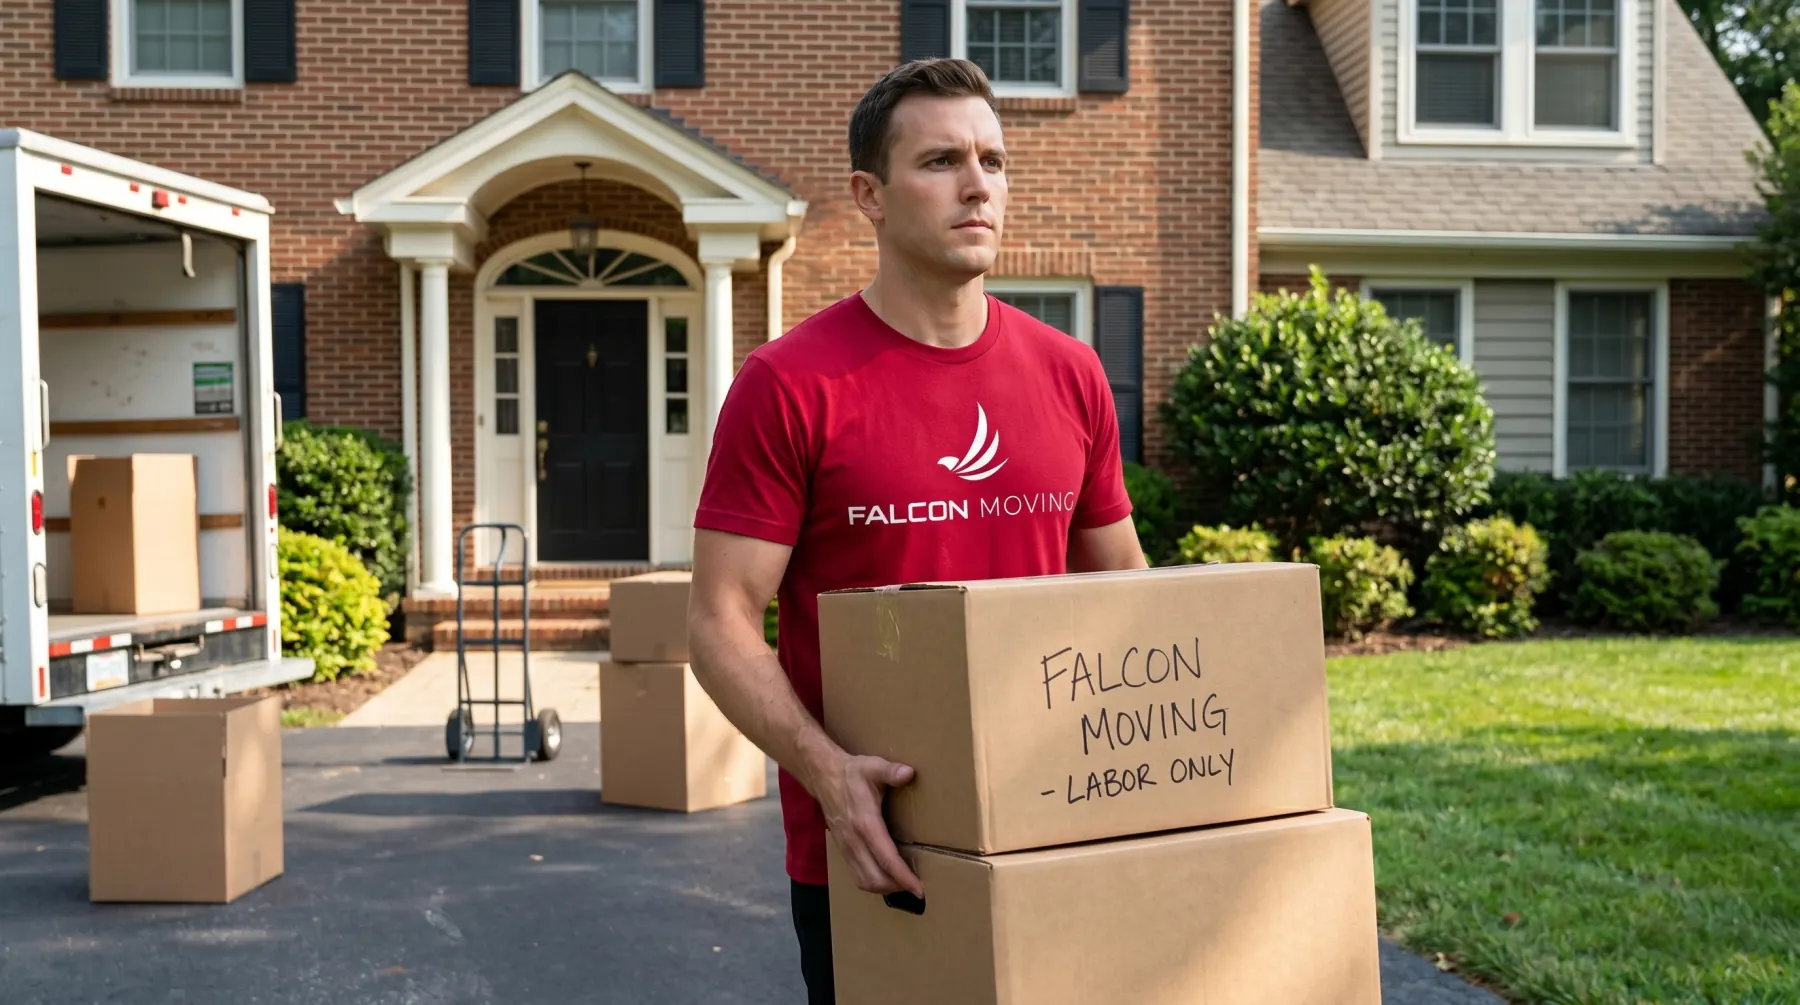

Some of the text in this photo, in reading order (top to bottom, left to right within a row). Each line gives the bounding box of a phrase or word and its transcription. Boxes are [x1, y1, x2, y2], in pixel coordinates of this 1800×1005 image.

[848, 491, 1075, 525] FALCON MOVING
[1041, 637, 1201, 709] FALCON
[1081, 693, 1230, 755] MOVING
[1170, 748, 1234, 786] ONLY
